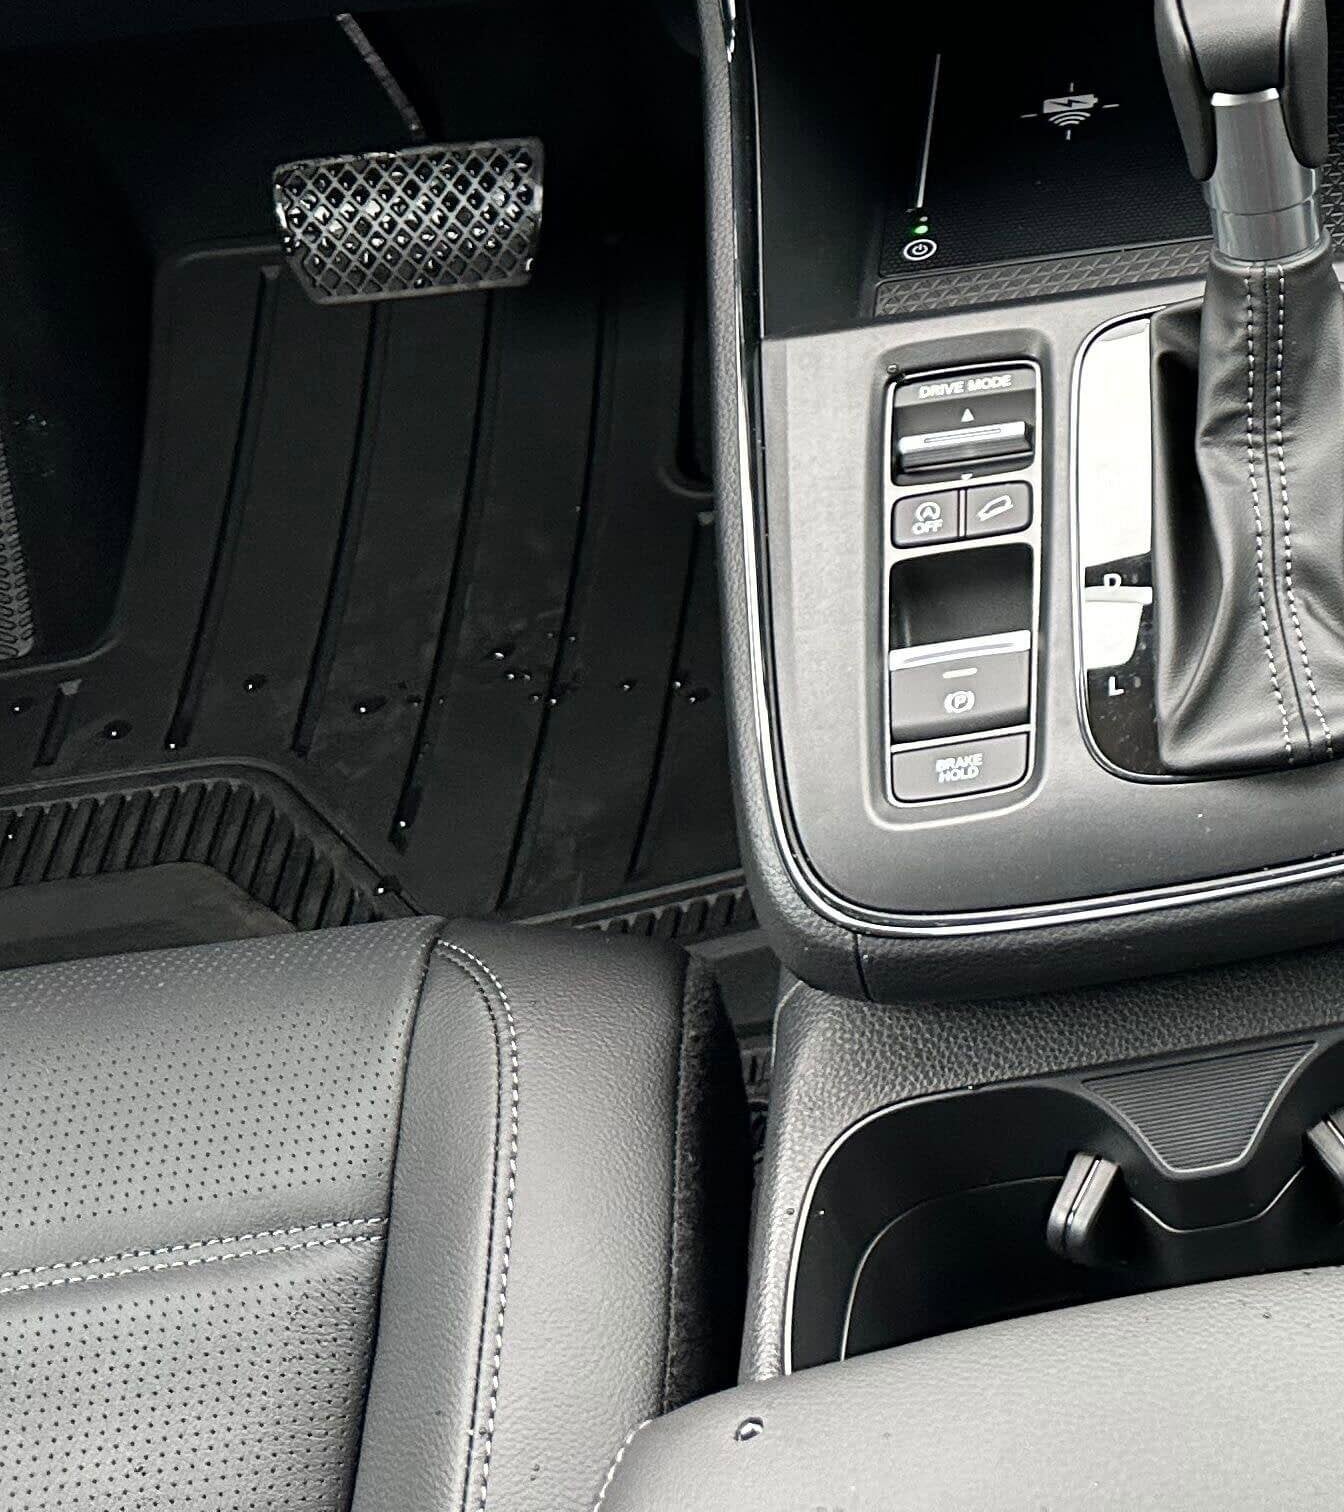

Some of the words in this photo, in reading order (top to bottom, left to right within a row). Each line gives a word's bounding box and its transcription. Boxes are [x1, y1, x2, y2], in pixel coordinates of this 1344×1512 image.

[918, 380, 965, 399] DRIVE
[967, 374, 1012, 392] MODE
[911, 519, 944, 535] OFF
[1103, 572, 1122, 589] D
[1108, 675, 1125, 696] L
[935, 752, 983, 774] BRAKE
[938, 765, 979, 784] HOLD
